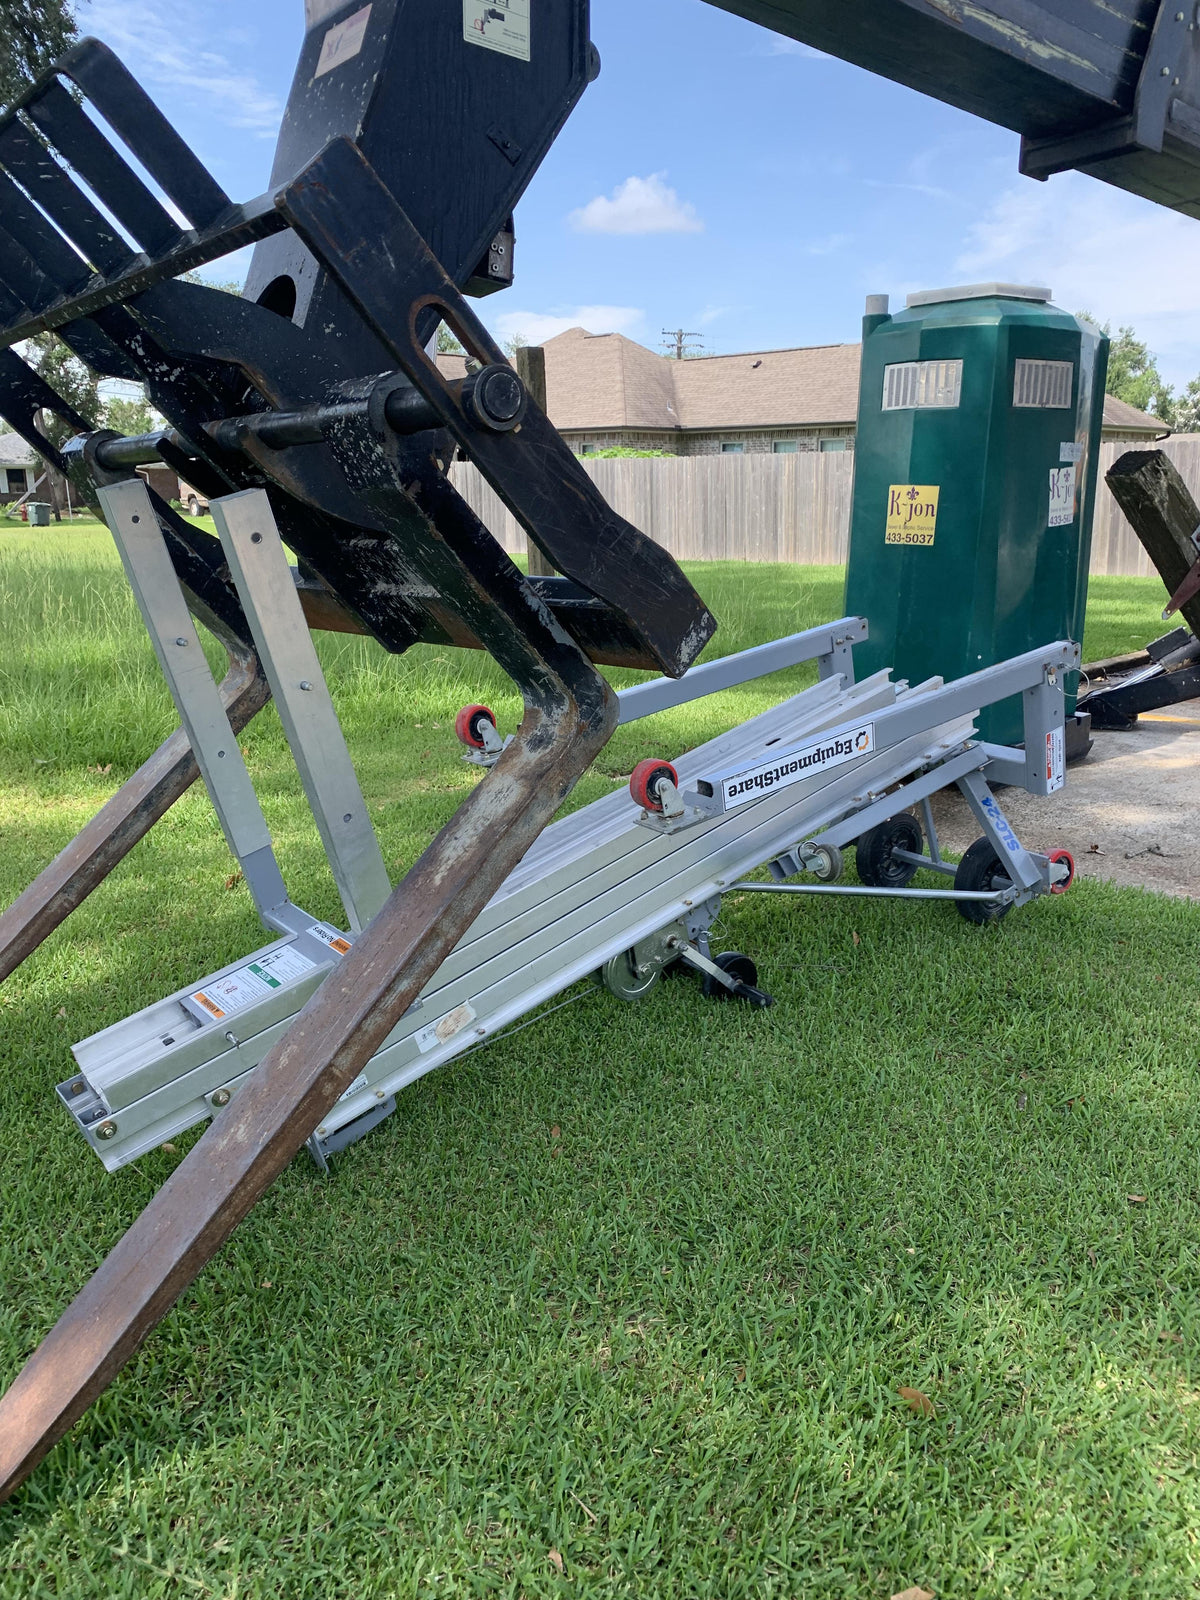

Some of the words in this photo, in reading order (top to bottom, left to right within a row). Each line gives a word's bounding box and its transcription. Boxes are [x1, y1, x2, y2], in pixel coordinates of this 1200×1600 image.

[1051, 473, 1075, 504] K-jo
[889, 490, 935, 522] K-jon
[886, 533, 933, 544] 433-5037
[728, 739, 853, 797] EquipmentShare
[981, 797, 1020, 851] SLC-24
